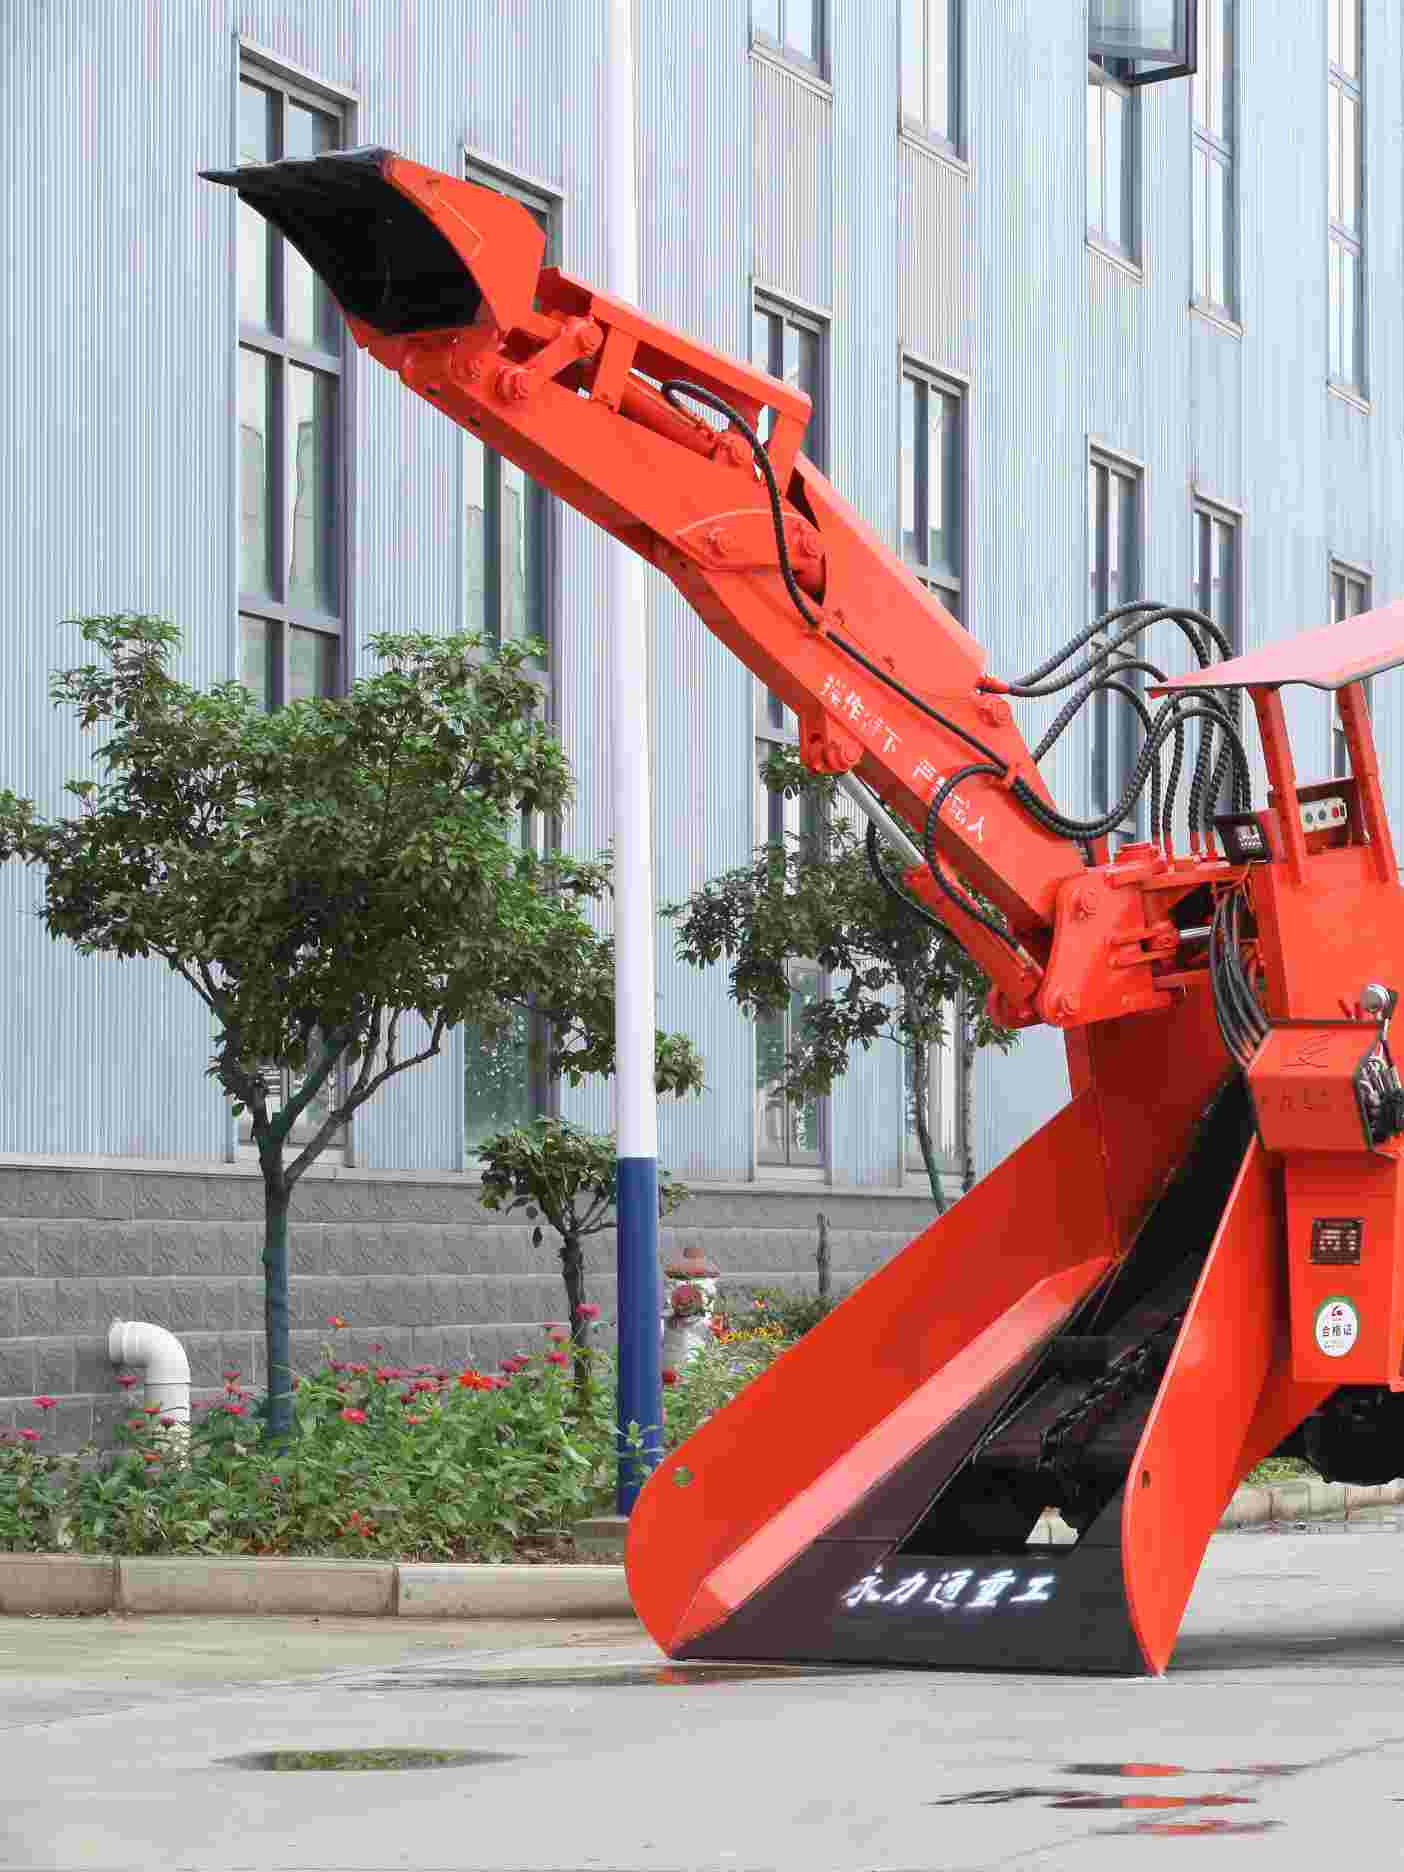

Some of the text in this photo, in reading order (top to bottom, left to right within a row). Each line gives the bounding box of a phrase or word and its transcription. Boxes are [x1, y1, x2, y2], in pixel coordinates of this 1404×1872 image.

[840, 1565, 1056, 1608] 永力通重工
